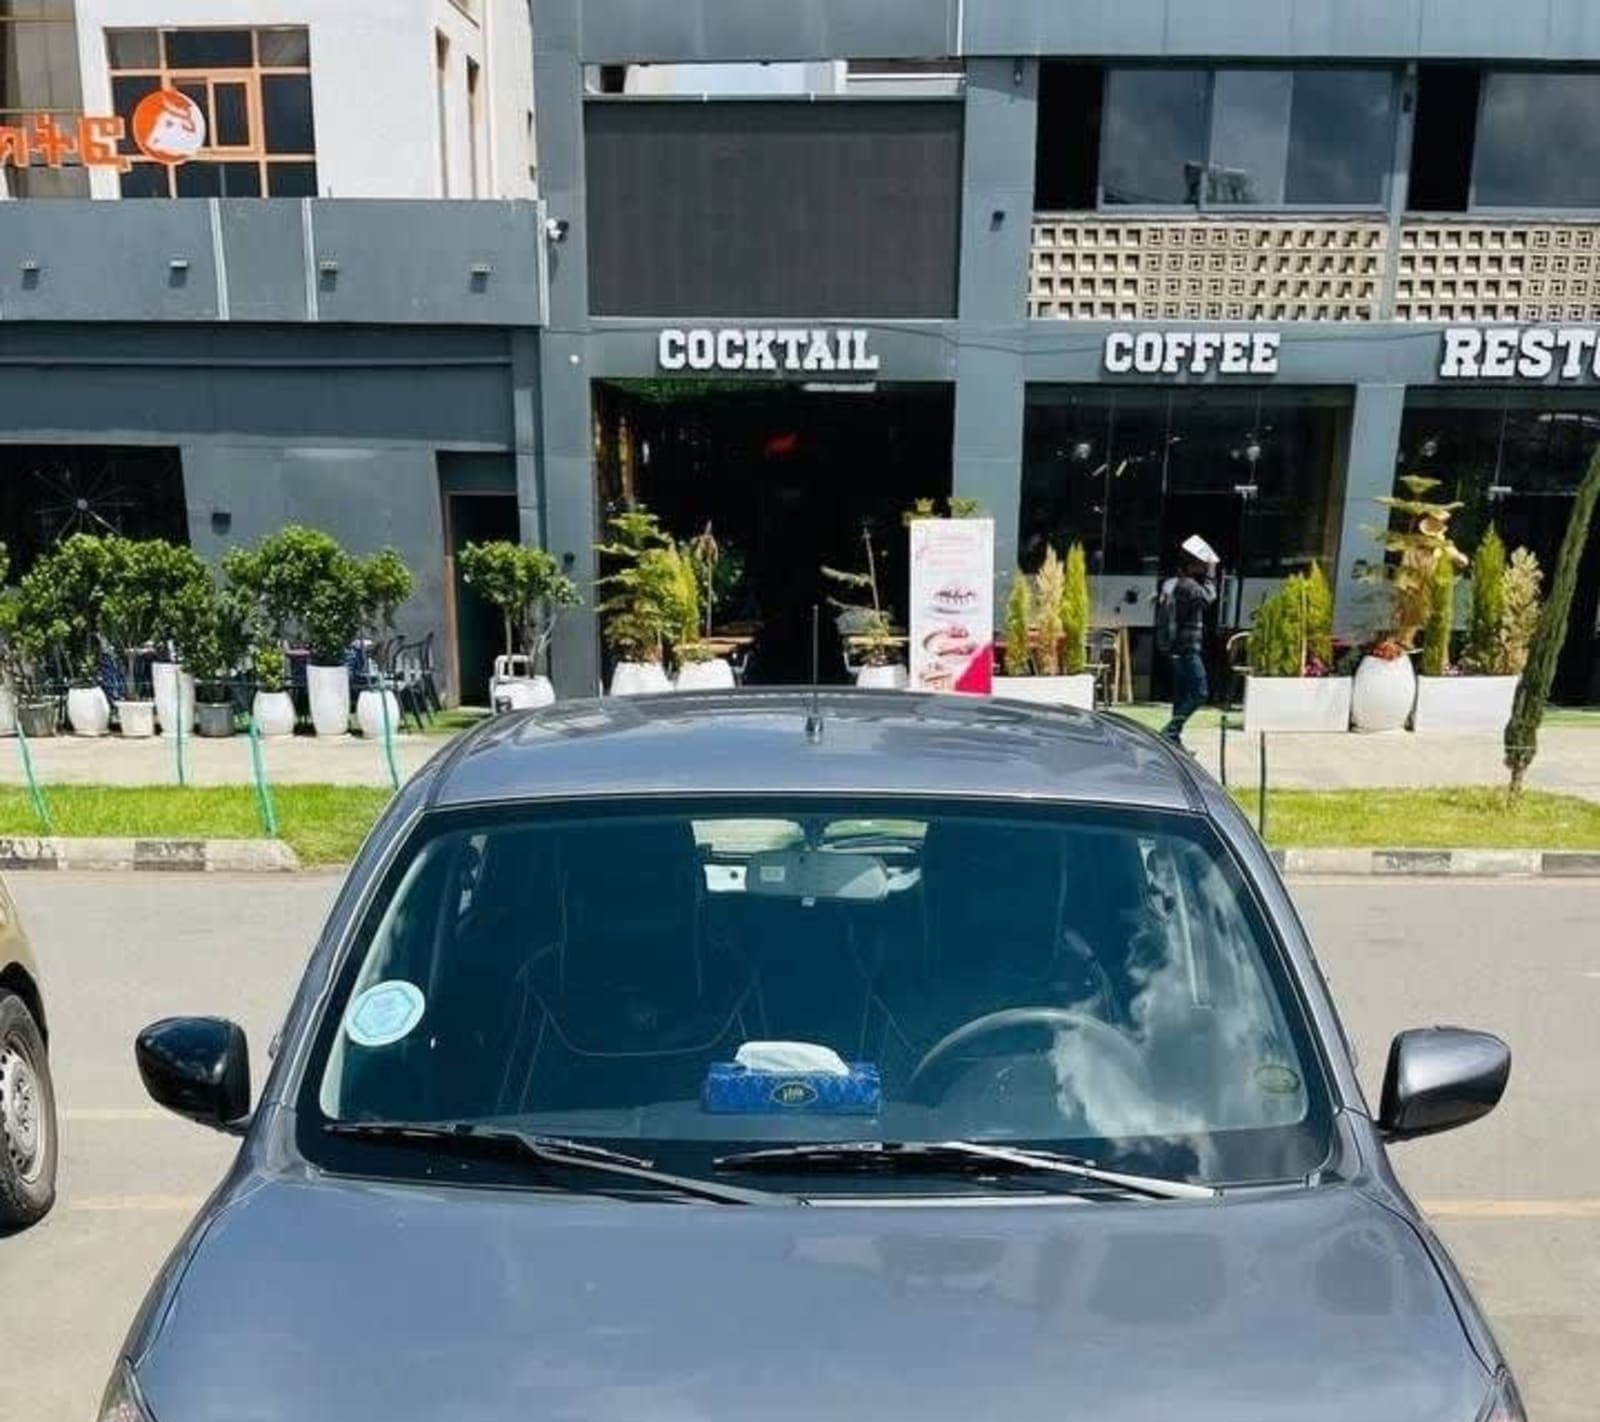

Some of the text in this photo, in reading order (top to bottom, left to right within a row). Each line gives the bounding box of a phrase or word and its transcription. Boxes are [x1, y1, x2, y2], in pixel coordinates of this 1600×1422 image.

[659, 329, 879, 370] COCKTAIL
[1105, 332, 1280, 373] COFFEE
[1440, 328, 1600, 378] REST
